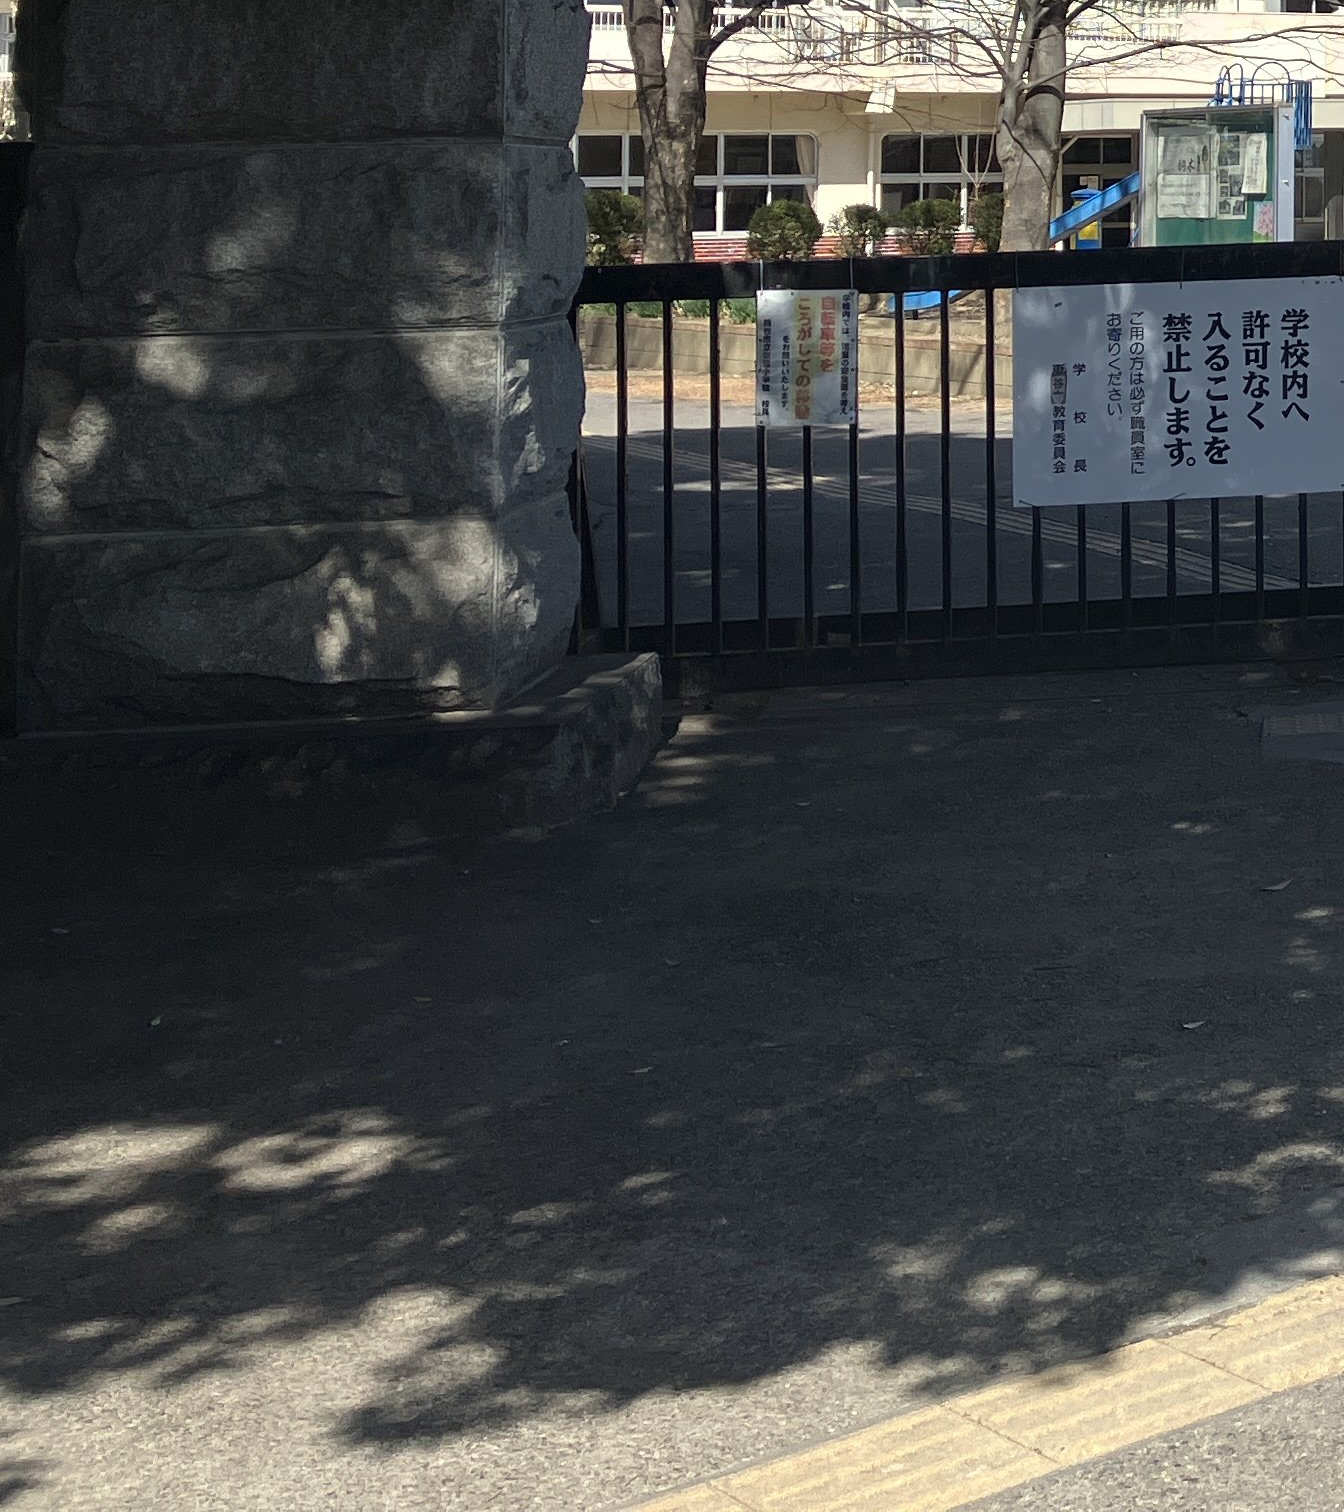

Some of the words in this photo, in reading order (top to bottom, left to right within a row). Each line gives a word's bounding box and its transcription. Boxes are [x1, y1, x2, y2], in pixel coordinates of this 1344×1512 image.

[1129, 311, 1146, 475] ご用の方は必ず職員室に
[1162, 312, 1197, 467] 禁止します。
[1202, 311, 1232, 466] 入ることを
[1241, 309, 1271, 431] 許可なく
[1280, 308, 1310, 422] 学校内へ
